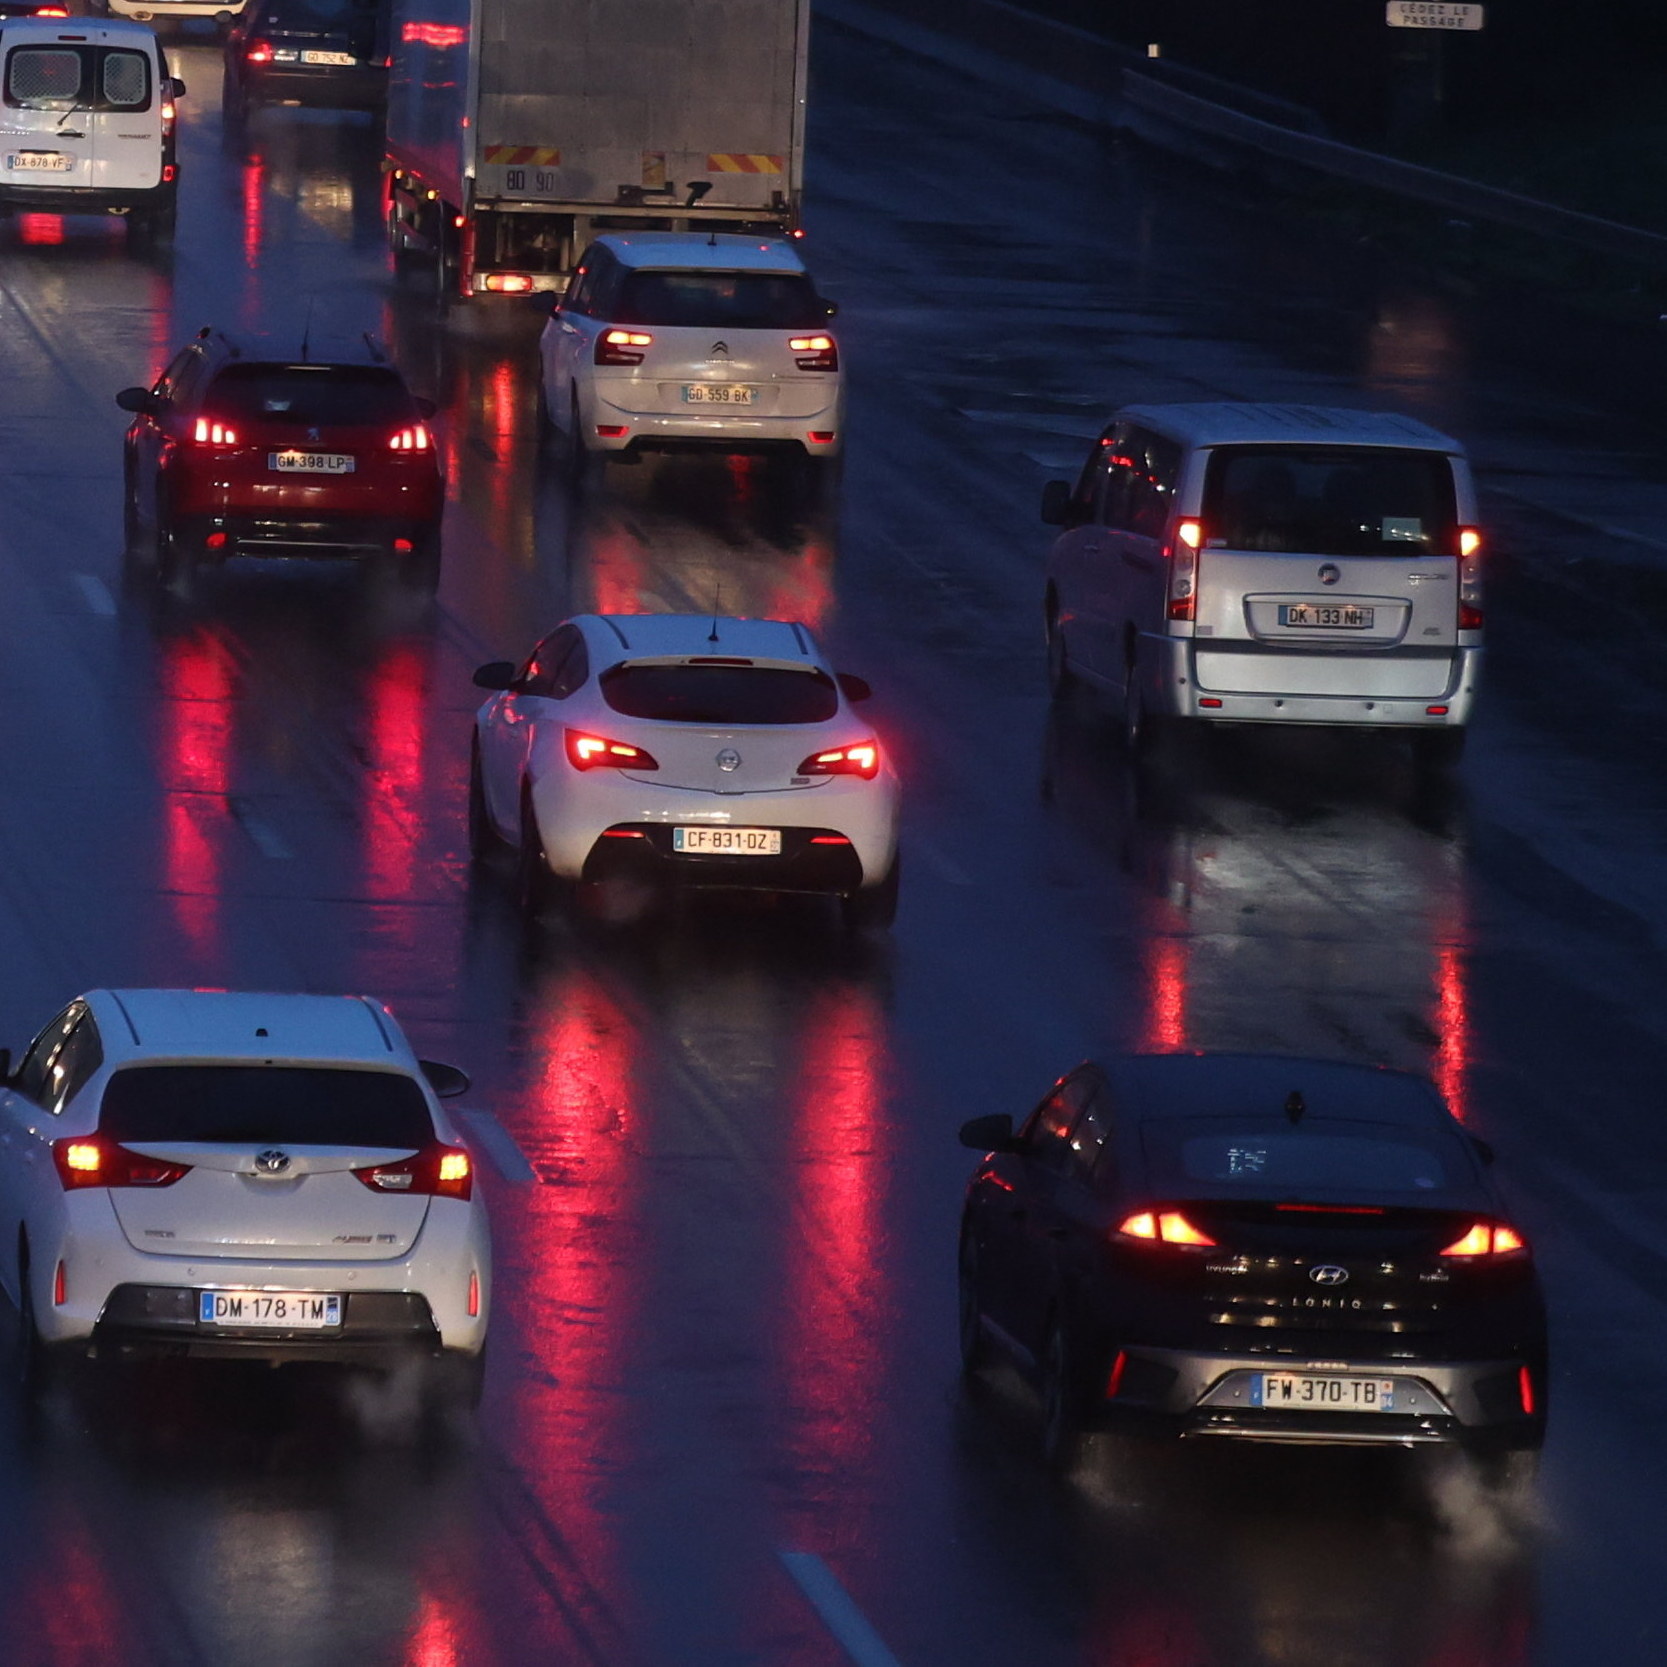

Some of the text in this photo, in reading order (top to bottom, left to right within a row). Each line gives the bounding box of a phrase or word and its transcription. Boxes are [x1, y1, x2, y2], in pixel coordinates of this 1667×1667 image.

[1453, 5, 1469, 16] LE
[1403, 14, 1466, 27] PASSAGE
[507, 170, 555, 193] 80 90
